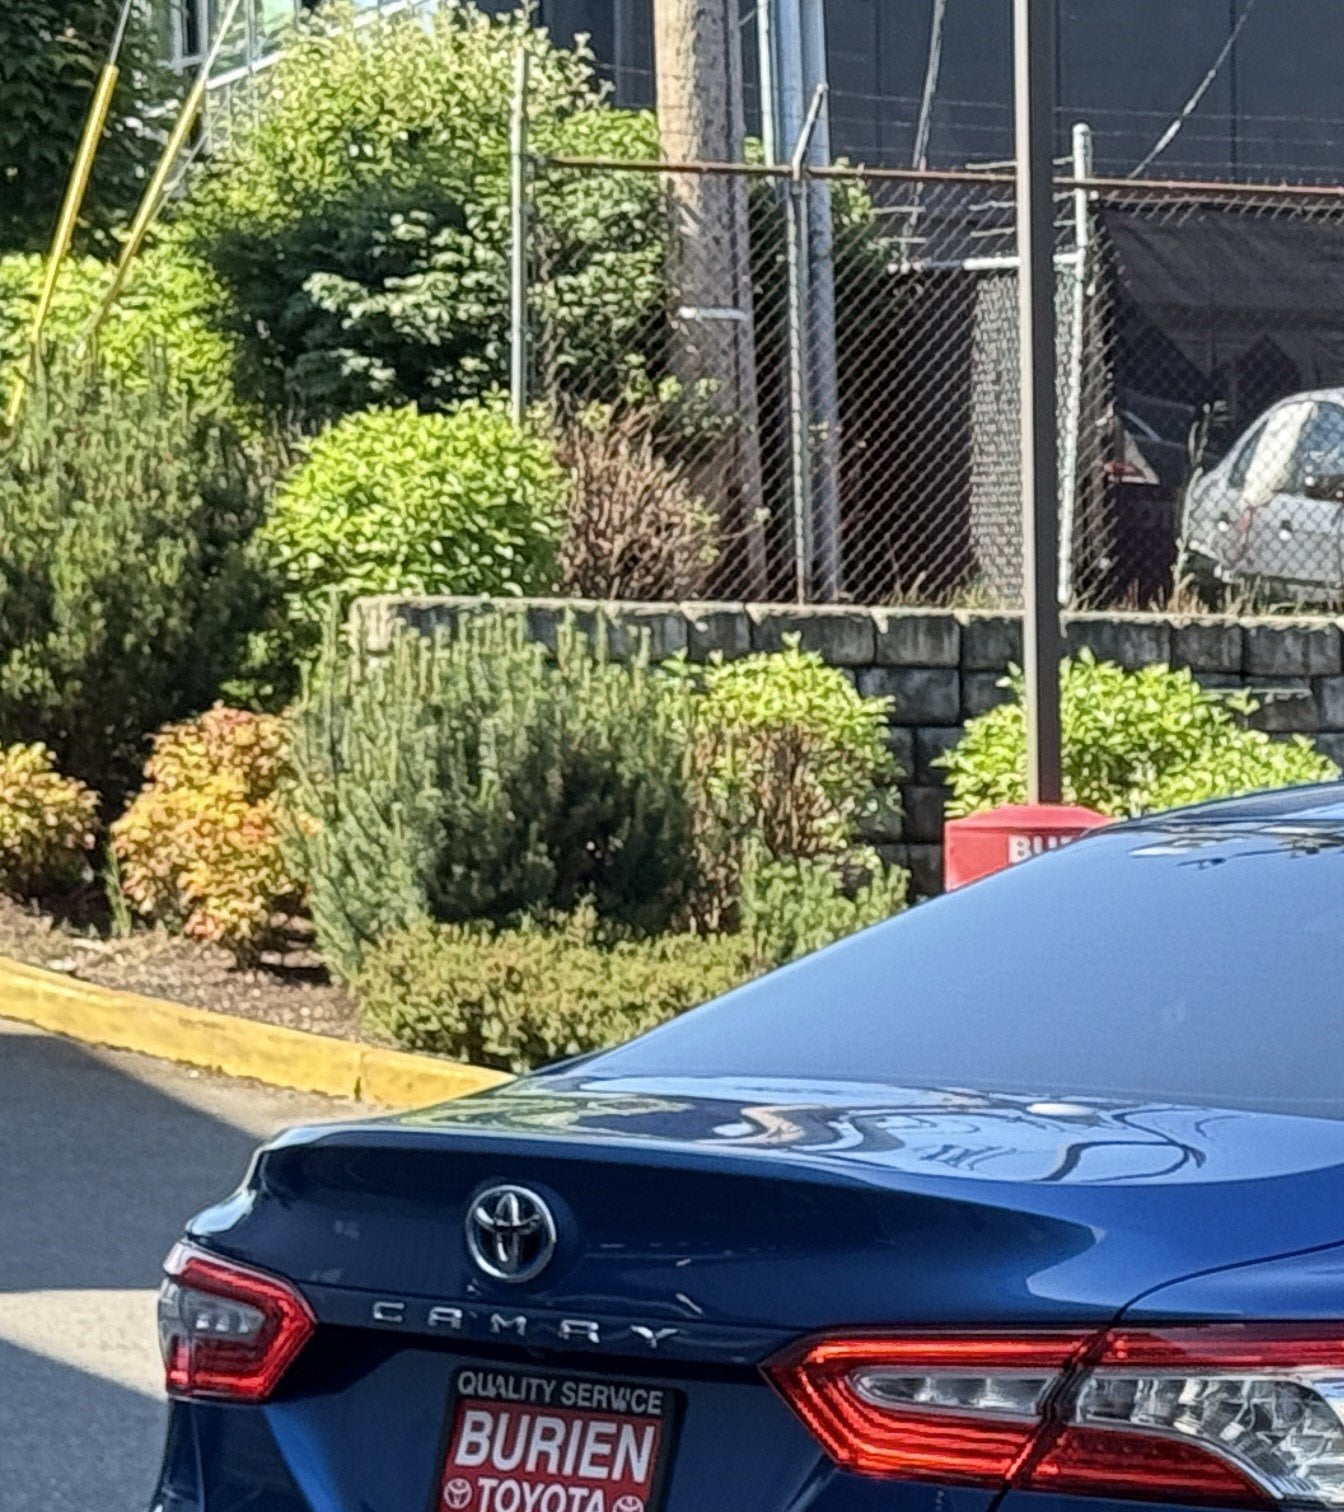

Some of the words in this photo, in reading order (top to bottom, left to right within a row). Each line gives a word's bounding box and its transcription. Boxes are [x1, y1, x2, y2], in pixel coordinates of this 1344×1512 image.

[373, 1301, 679, 1348] CAMRY
[457, 1370, 557, 1401] QUALITY
[454, 1410, 656, 1484] BURIEN
